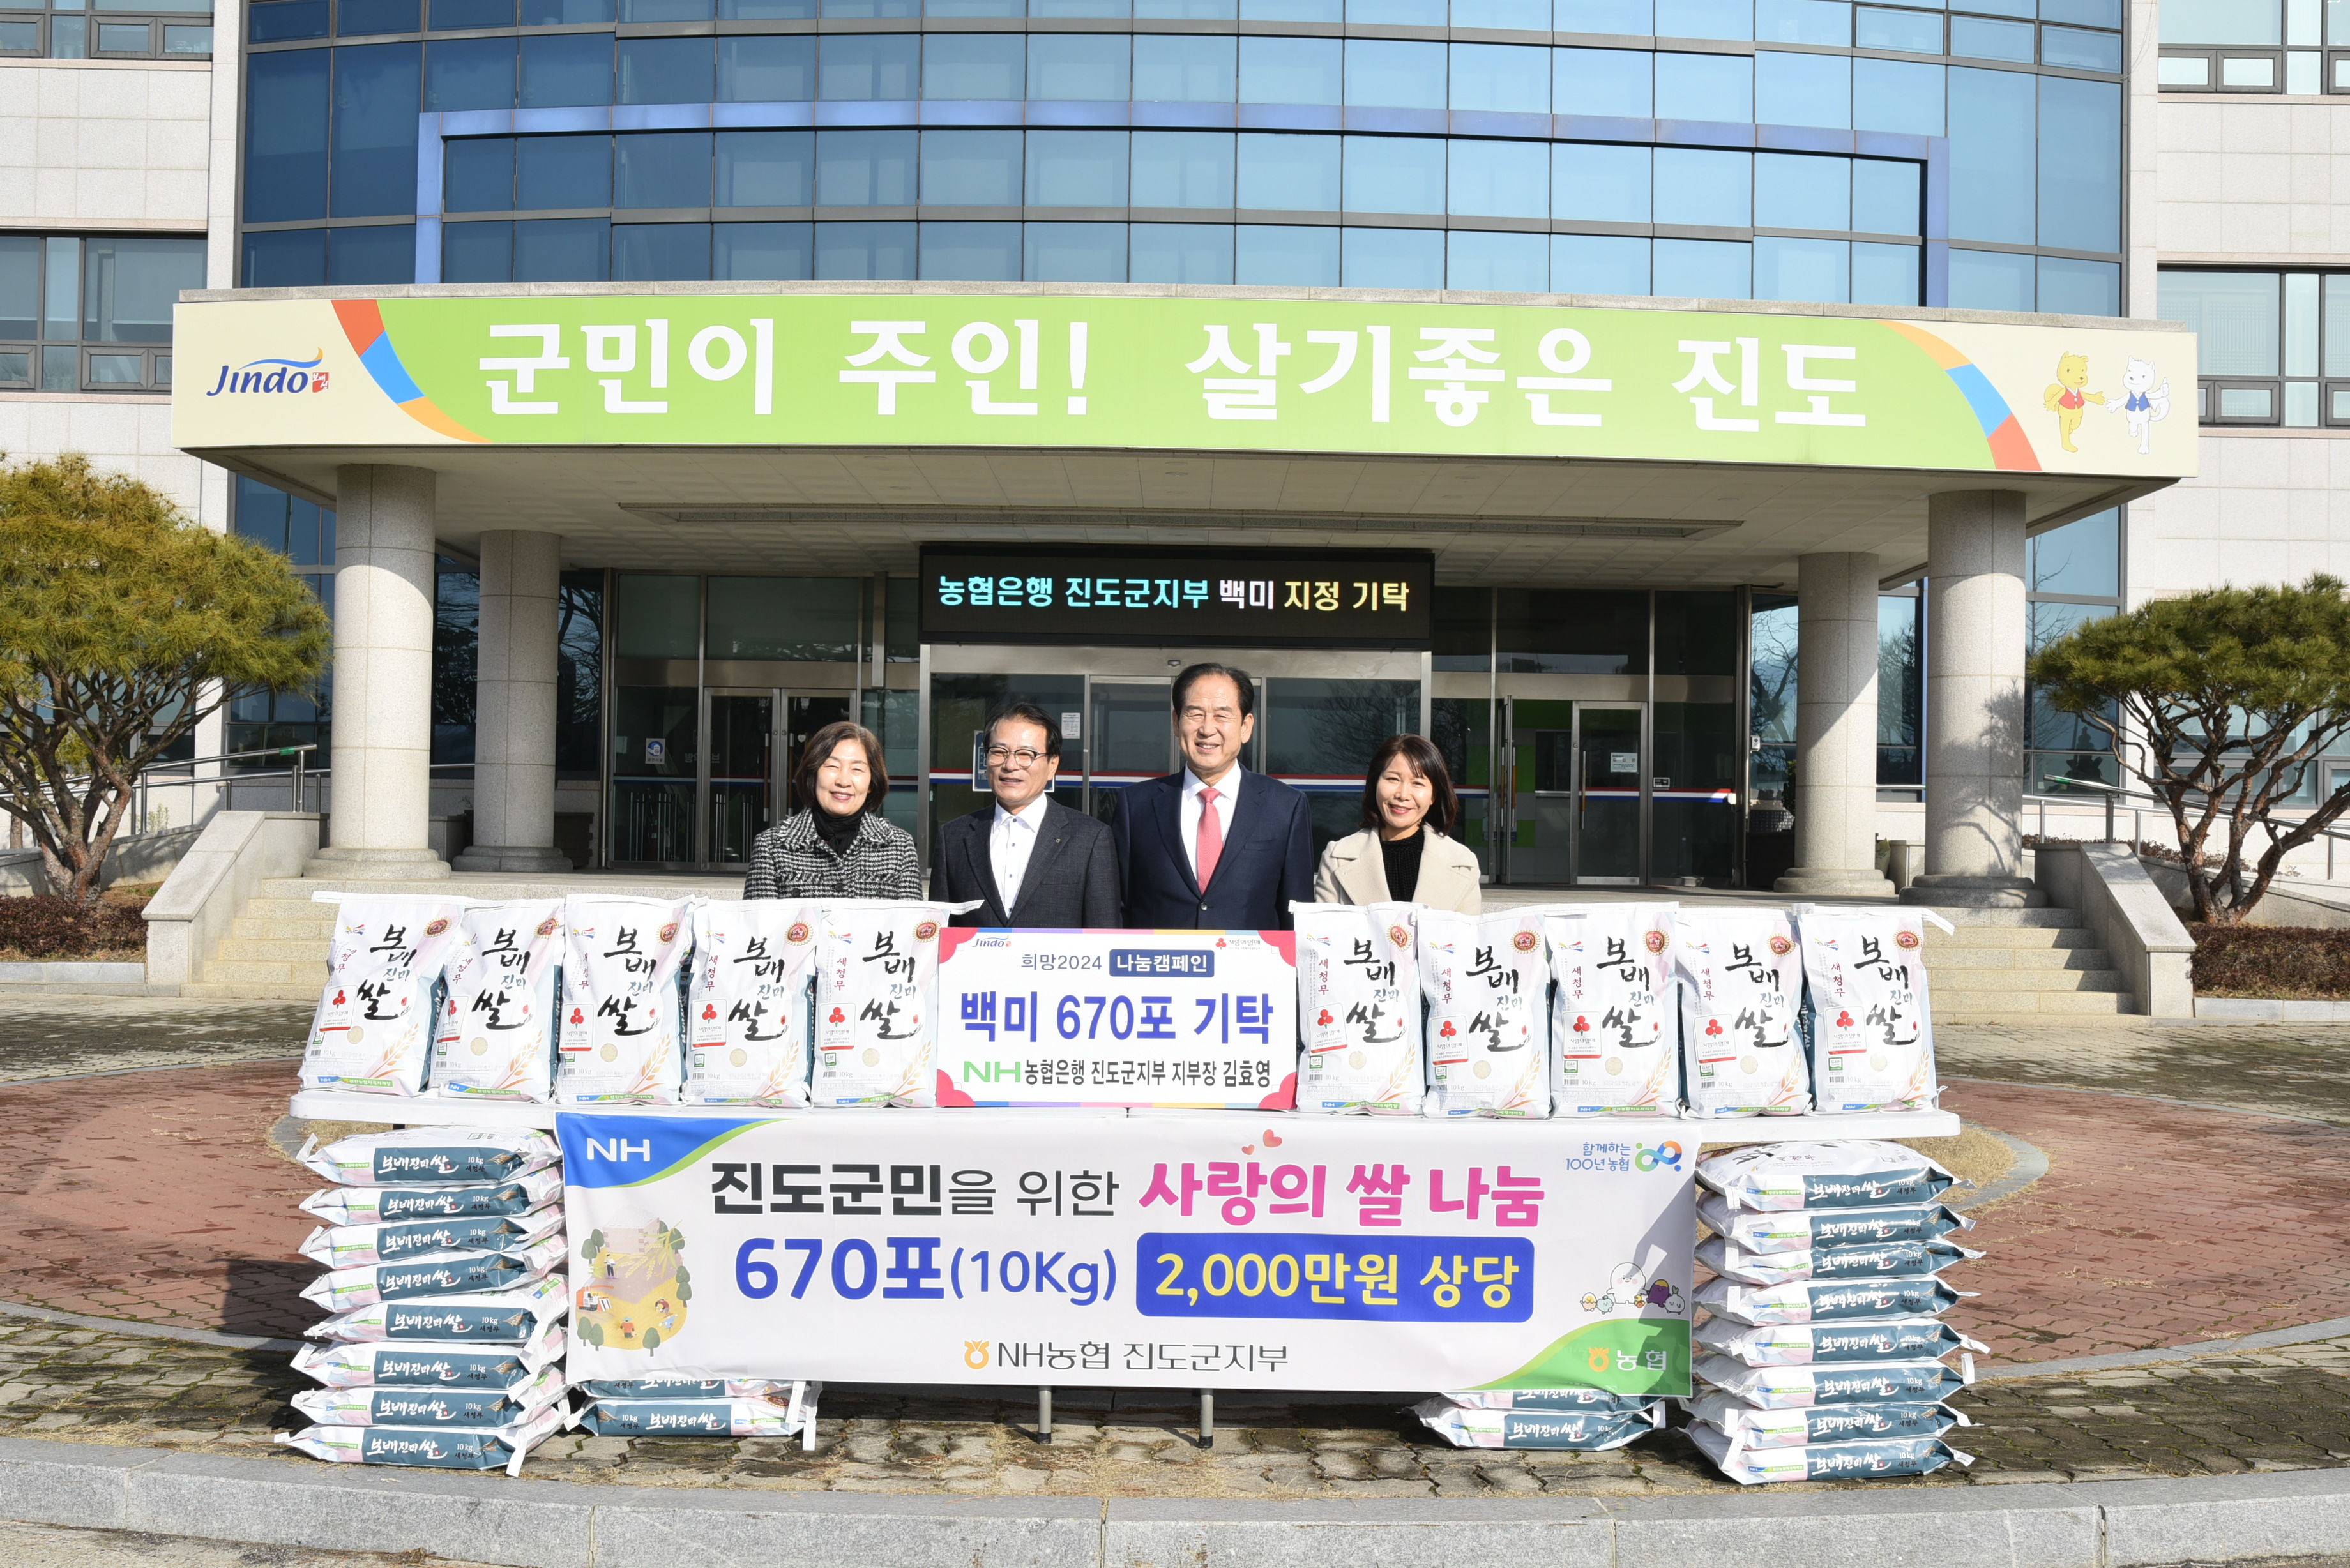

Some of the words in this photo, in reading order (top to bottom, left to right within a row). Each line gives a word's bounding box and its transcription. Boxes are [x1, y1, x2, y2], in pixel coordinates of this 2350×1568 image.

[206, 365, 308, 396] Jindo
[479, 318, 773, 415] 군민이
[838, 319, 1088, 416] 주인!
[1185, 322, 1612, 427] 살기좋은
[1671, 336, 1867, 432] 진도
[938, 575, 1053, 608] 농협은행
[1065, 577, 1209, 610] 진도군지부
[1219, 579, 1275, 610] 백미
[1284, 580, 1340, 612] 지정
[1353, 581, 1410, 612] 기탁
[370, 924, 417, 967] 보배
[482, 928, 531, 974] 보배
[603, 925, 657, 981] 보배
[733, 935, 785, 983] 보배
[862, 930, 916, 983] 보배
[972, 937, 1004, 949] Jindo
[336, 948, 357, 973] 새청무
[383, 967, 411, 982] 진미
[453, 958, 473, 984] 새청무
[705, 955, 718, 991] 새청무
[834, 957, 847, 991] 새청무
[1021, 953, 1103, 971] 희망2024
[1117, 954, 1208, 973] 나눔캠페인
[1318, 958, 1330, 995] 새청무
[1344, 937, 1395, 986] 보배
[1466, 945, 1519, 994] 보배
[1596, 936, 1650, 991] 보배
[1725, 942, 1780, 992] 보배
[1854, 935, 1909, 990] 보배
[501, 974, 526, 990] 진미
[628, 981, 654, 997] 진미
[757, 984, 784, 1000] 진미
[890, 983, 916, 999] 진미
[1374, 988, 1399, 1002] 진미
[1441, 967, 1452, 1004] 새청무
[1572, 965, 1584, 999] 새청무
[1701, 968, 1715, 1001] 새청무
[1831, 963, 1846, 997] 새청무
[357, 979, 411, 1020] 쌀
[471, 988, 533, 1030] 쌀
[1496, 995, 1523, 1011] 진미
[1629, 991, 1654, 1007] 진미
[1760, 992, 1784, 1008] 진미
[1890, 990, 1913, 1006] 진미
[597, 994, 661, 1036] 쌀
[728, 998, 789, 1041] 쌀
[860, 997, 923, 1040] 쌀
[960, 991, 1037, 1043] 백미
[1056, 994, 1176, 1041] 670포
[1194, 993, 1273, 1044] 기탁
[1346, 1001, 1407, 1043] 쌀
[1469, 1010, 1531, 1052] 쌀
[1602, 1006, 1664, 1048] 쌀
[1735, 1007, 1790, 1048] 쌀
[1866, 1004, 1921, 1046] 쌀
[1091, 1059, 1166, 1086] 진도군지부
[1172, 1060, 1217, 1087] 지부장
[1222, 1060, 1270, 1088] 김효영
[586, 1138, 650, 1162] NH
[1566, 1158, 1605, 1171] 100년
[1608, 1157, 1630, 1172] 농협
[1583, 1142, 1631, 1156] 함께하는
[466, 1165, 485, 1173] 새청무
[710, 1162, 997, 1216] 진도군민을
[1016, 1169, 1120, 1217] 위한
[1139, 1161, 1326, 1226] 사랑의
[1346, 1163, 1411, 1227] 쌀
[1429, 1166, 1545, 1228] 나눔
[1897, 1186, 1916, 1195] 새청무
[471, 1203, 492, 1211] 새청무
[467, 1237, 489, 1245] 새청무
[468, 1274, 489, 1282] 새청무
[1904, 1259, 1924, 1267] 새청무
[1156, 1253, 1398, 1307] 2,000만원
[1420, 1255, 1519, 1308] 상당
[1900, 1298, 1922, 1306] 새청무
[480, 1325, 500, 1333] 새청무
[997, 1341, 1110, 1371] NH농협
[1123, 1343, 1288, 1373] 진도군지부
[1616, 1348, 1667, 1371] 농협
[467, 1373, 487, 1381] 새청무
[1905, 1385, 1925, 1394] 새청무
[454, 1451, 474, 1459] 새청무
